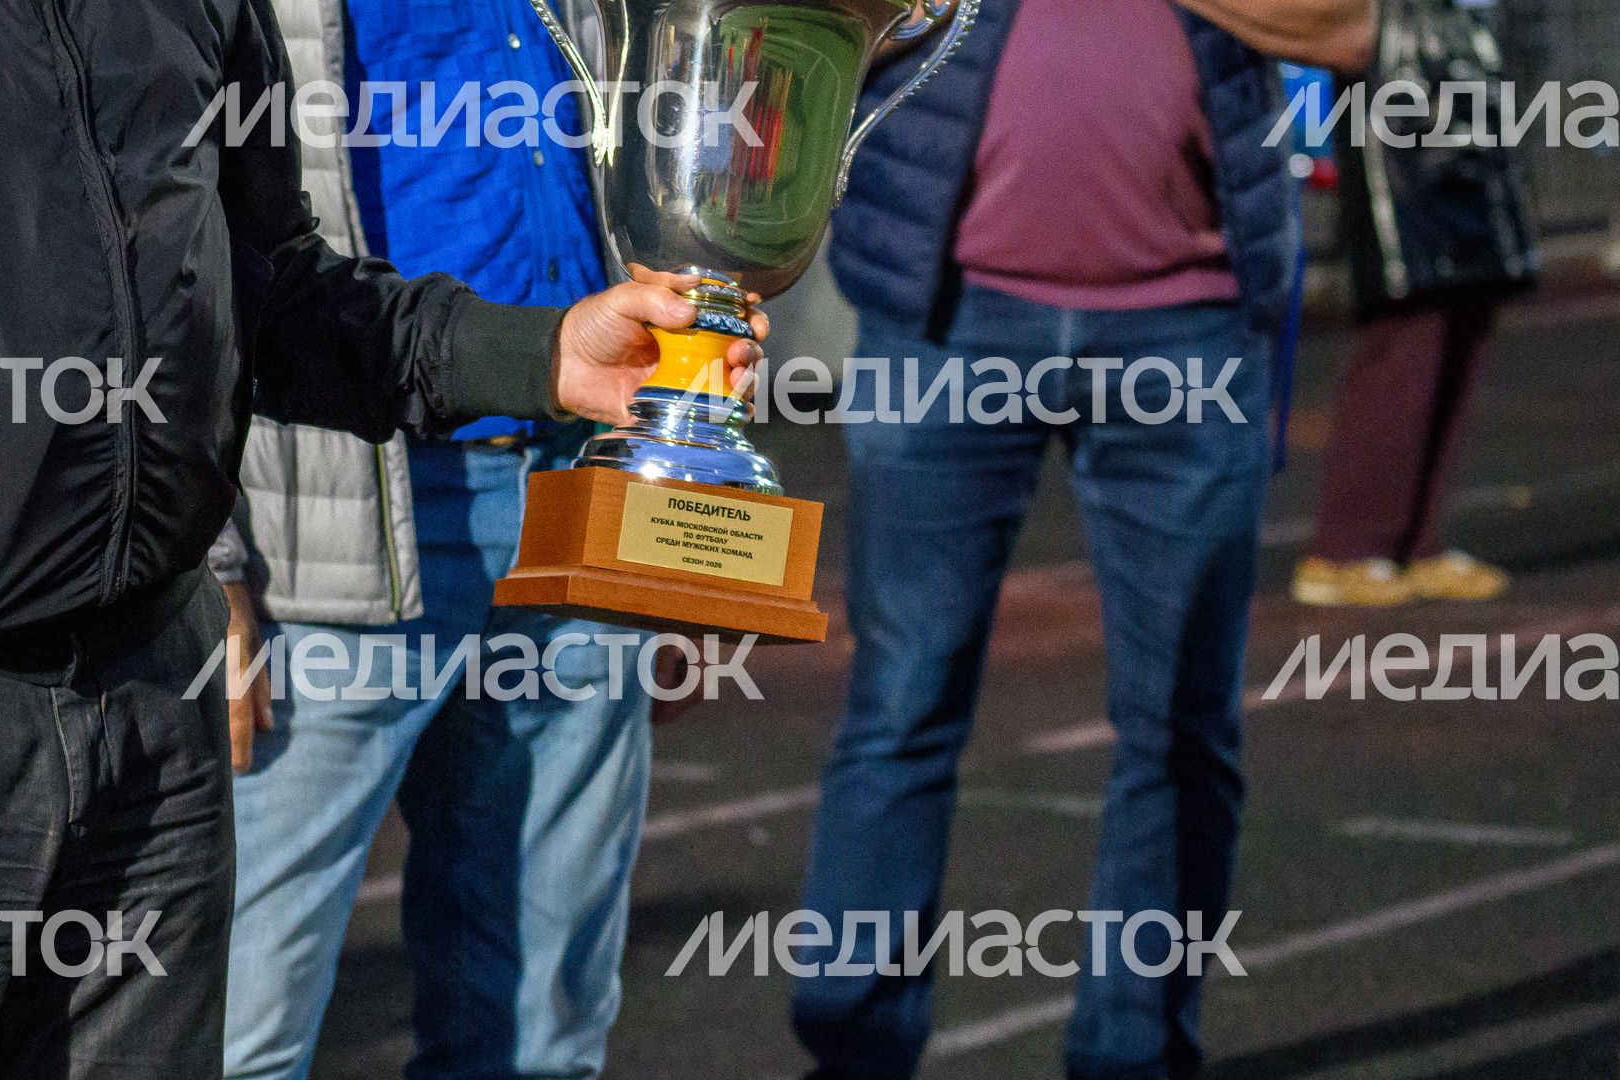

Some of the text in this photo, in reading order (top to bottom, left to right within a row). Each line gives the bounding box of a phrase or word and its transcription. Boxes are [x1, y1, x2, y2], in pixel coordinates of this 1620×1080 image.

[668, 497, 751, 521] ПОБЕДИТЕЛЬ
[651, 516, 764, 540] КУБКА МОСКОВСКОЙ ОБЛАСТИ
[683, 531, 729, 544] ПО ФУТБОЛУ
[655, 536, 753, 559] СРЕДИ МУЖСКИХ КОМАНД
[682, 556, 704, 565] СЕЗОН
